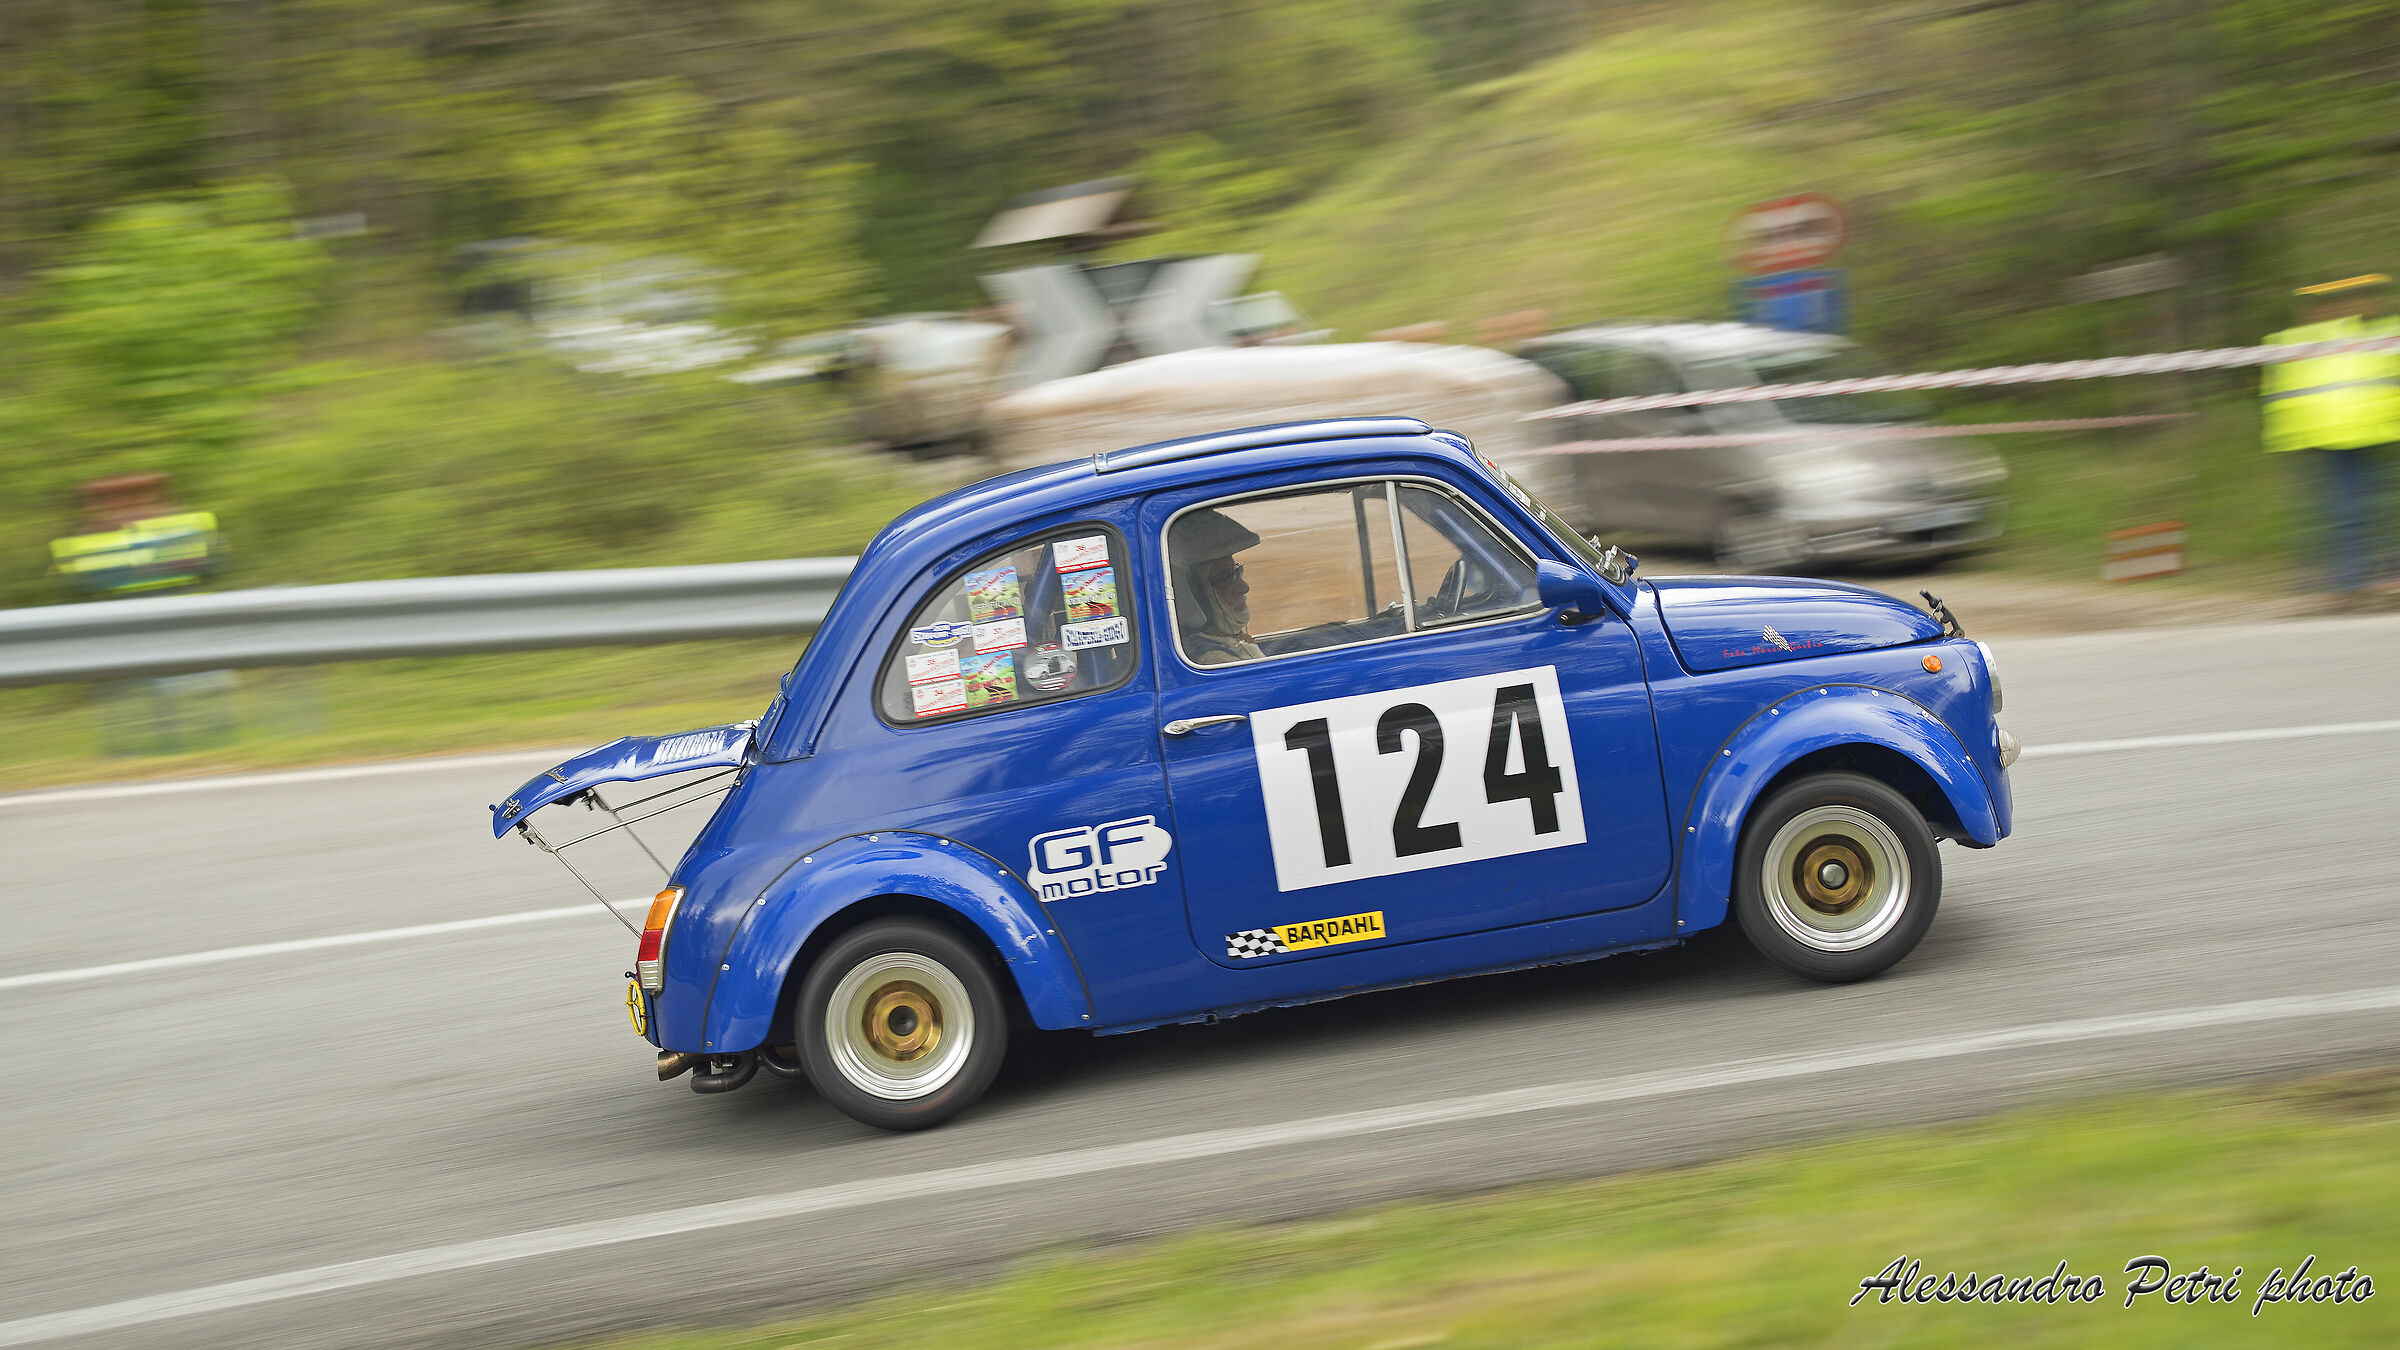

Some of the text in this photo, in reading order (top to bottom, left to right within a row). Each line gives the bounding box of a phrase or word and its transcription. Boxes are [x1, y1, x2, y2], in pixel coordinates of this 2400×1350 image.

[1283, 682, 1563, 868] 124
[1034, 818, 1150, 875] GF
[1042, 864, 1163, 900] motor
[1287, 915, 1381, 944] BARDAHL
